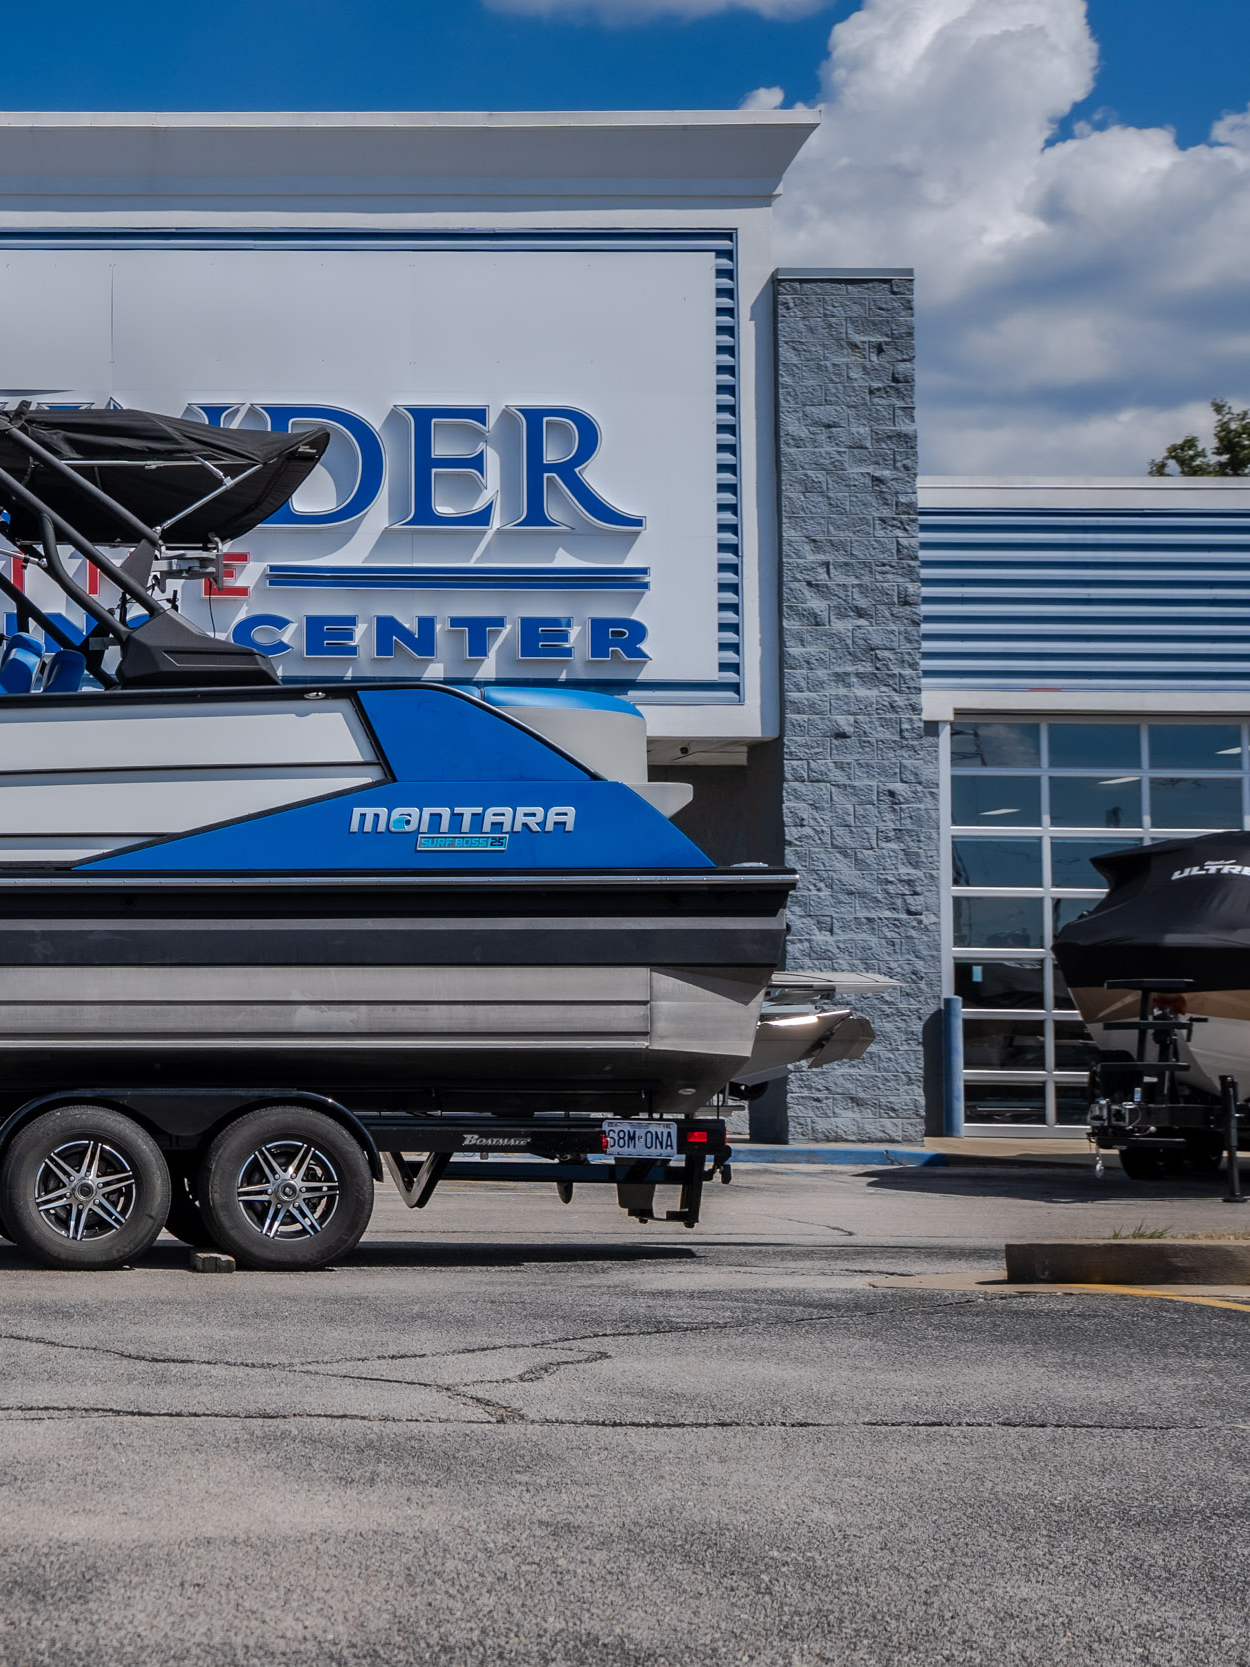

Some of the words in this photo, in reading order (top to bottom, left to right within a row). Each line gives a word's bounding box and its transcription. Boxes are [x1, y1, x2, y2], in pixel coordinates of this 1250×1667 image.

[231, 613, 652, 660] CENTER
[350, 806, 576, 833] MONTARA
[421, 837, 453, 848] SURF
[455, 837, 487, 848] BOSS
[490, 838, 504, 847] 25
[462, 1134, 531, 1146] BOATMATE
